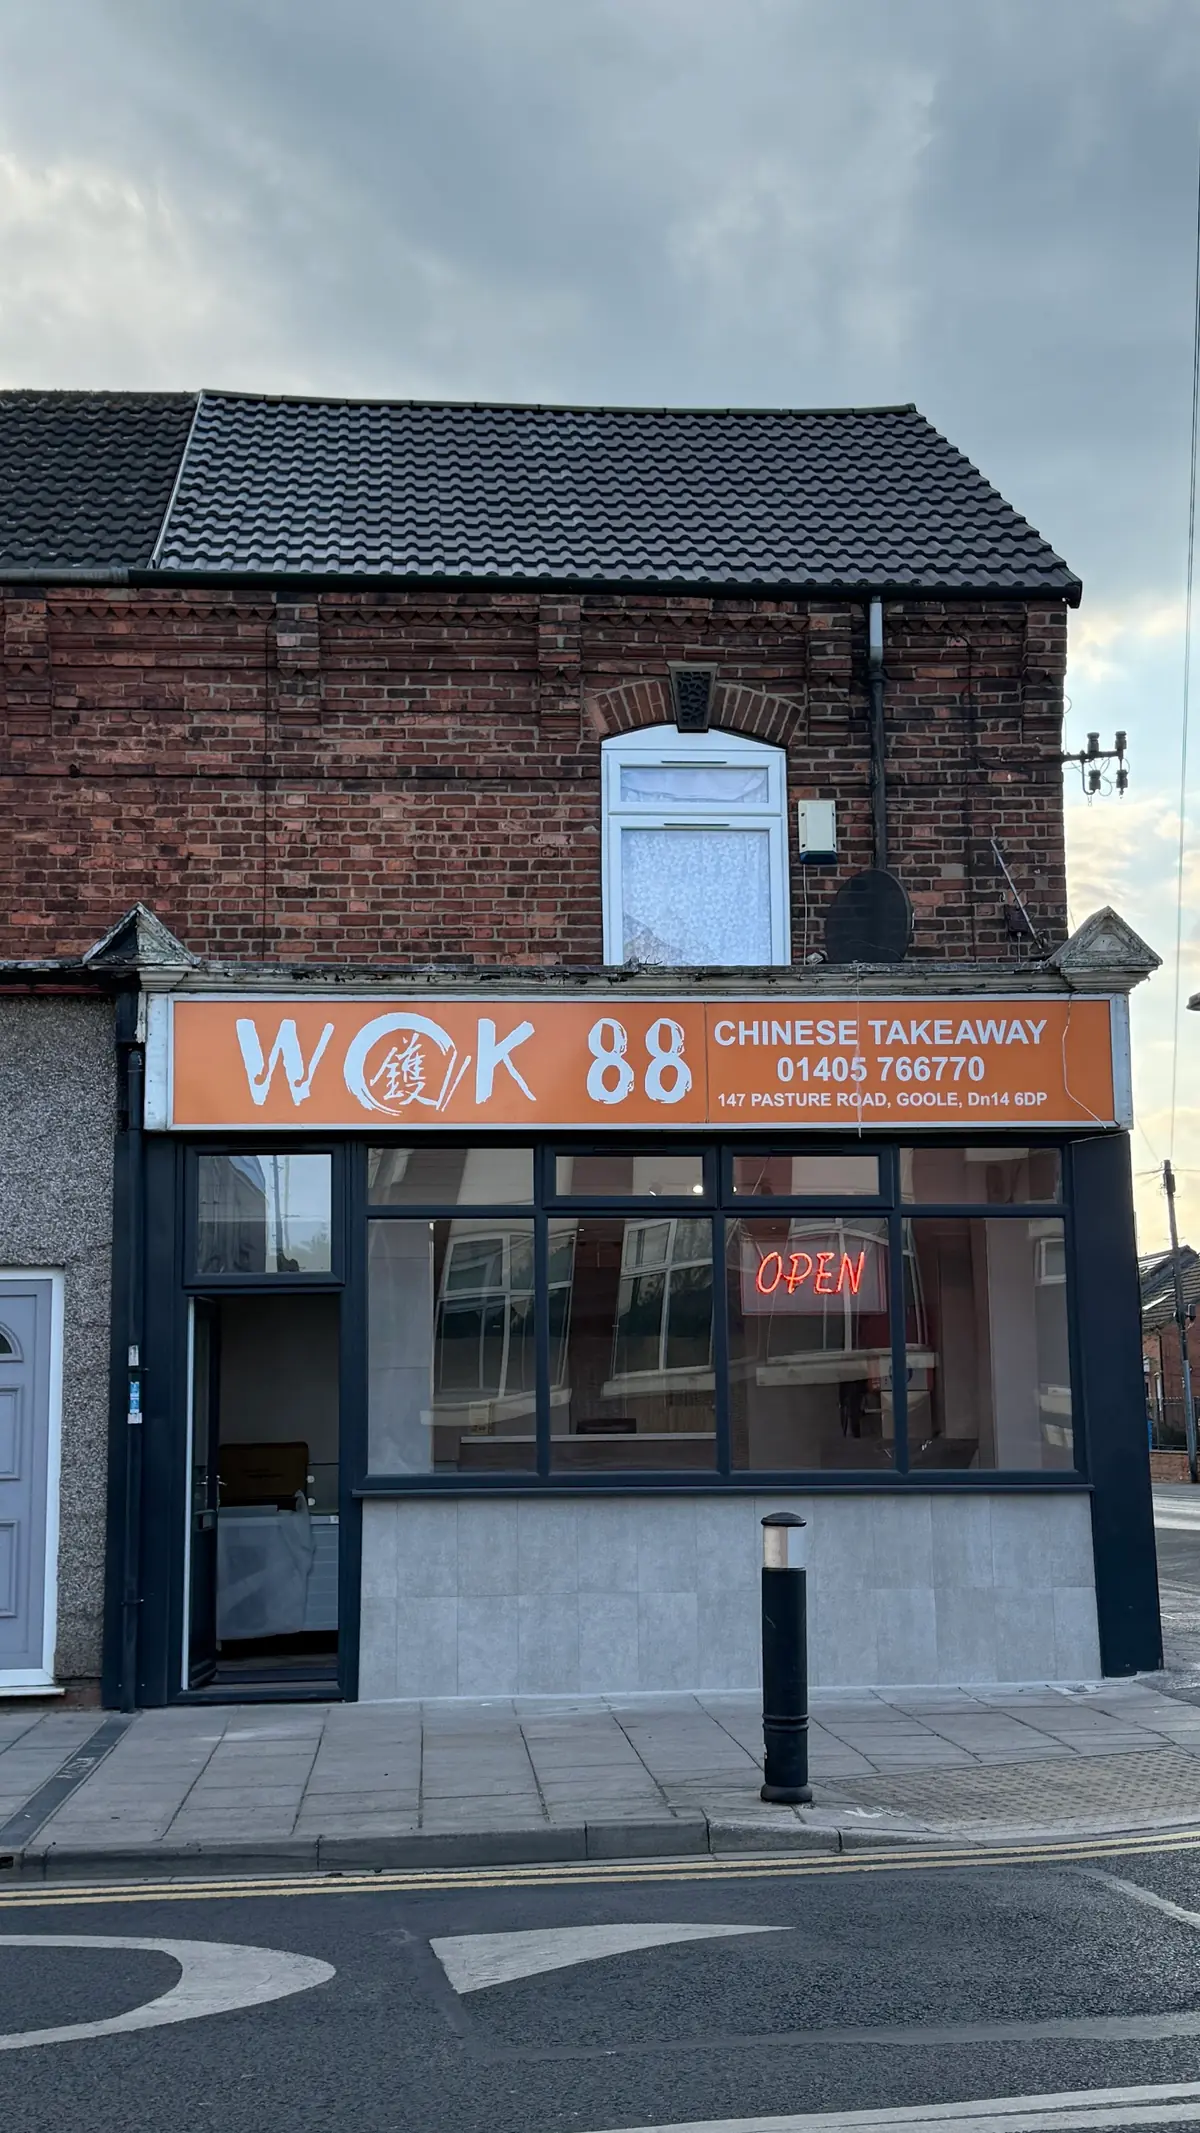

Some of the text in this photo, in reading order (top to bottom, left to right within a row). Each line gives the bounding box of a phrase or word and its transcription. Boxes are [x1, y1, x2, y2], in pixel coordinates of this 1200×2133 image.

[713, 1018, 1048, 1047] CHINESE TAKEAWAY
[236, 1011, 693, 1116] WOK 88
[776, 1055, 986, 1083] 01405 766770
[717, 1091, 1048, 1109] 147 PASTURE ROAD, GOOLE, Dn14 6DP
[756, 1251, 866, 1295] OPEN
